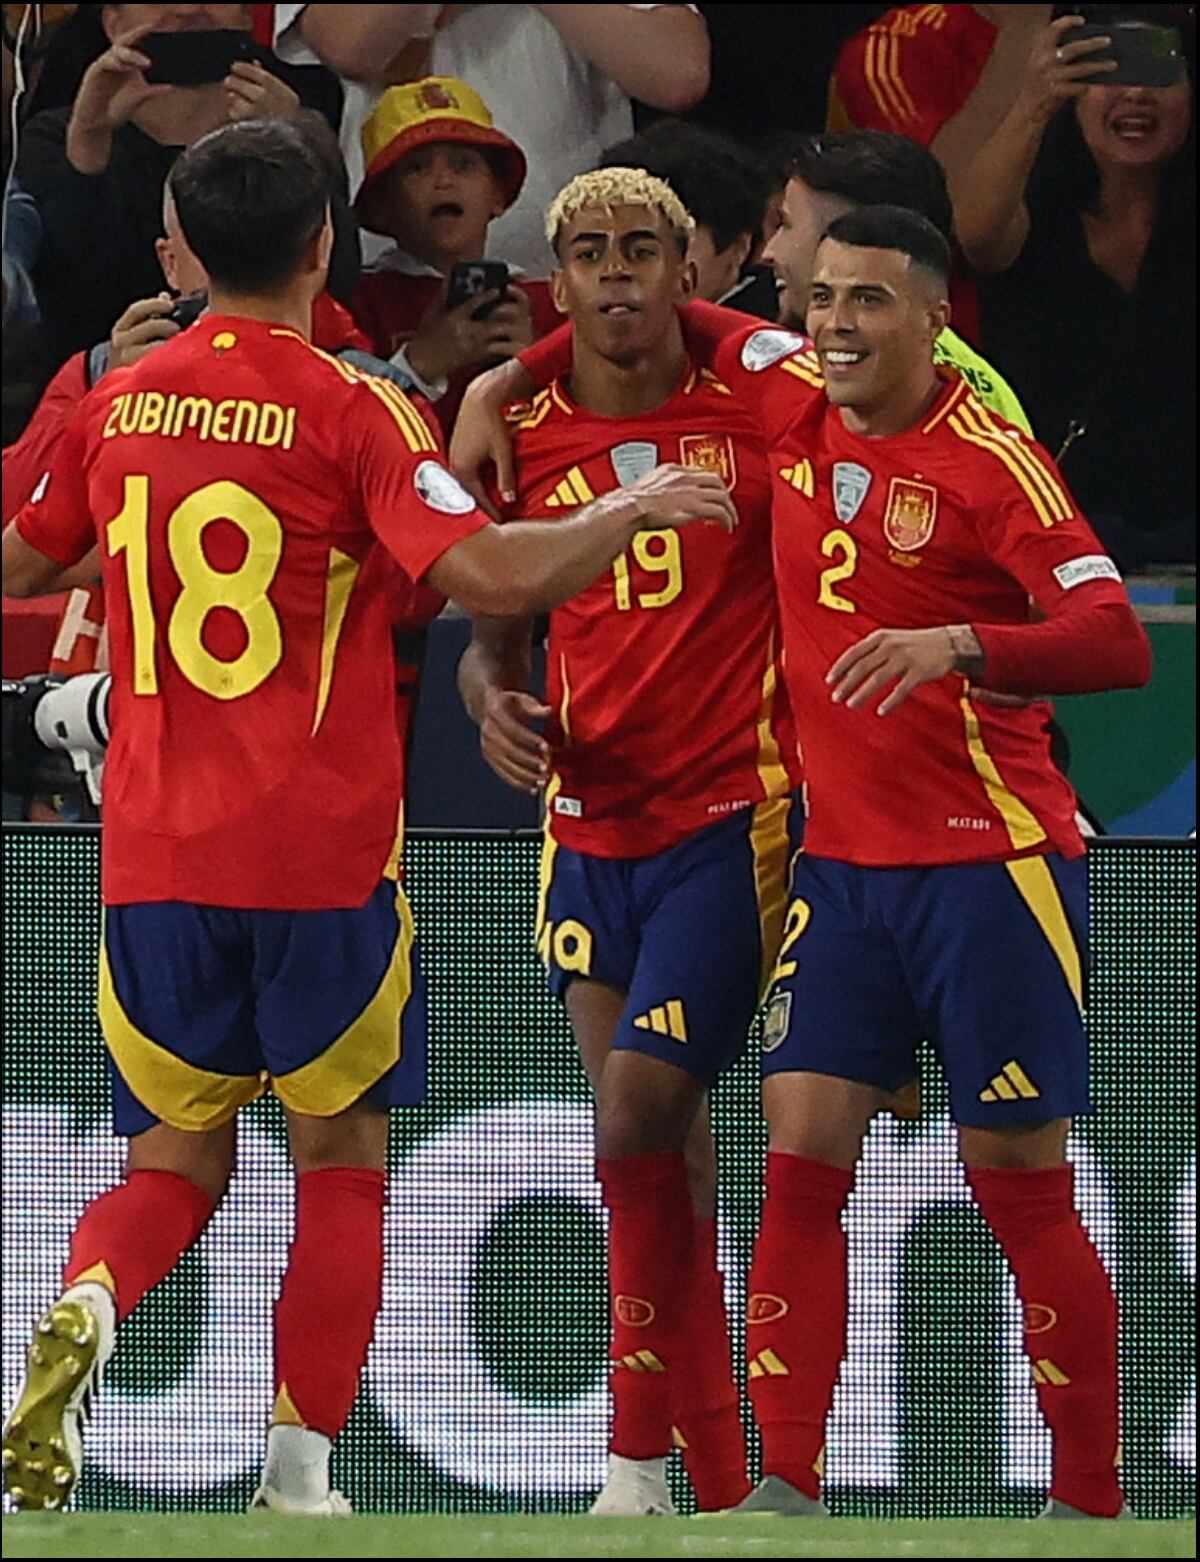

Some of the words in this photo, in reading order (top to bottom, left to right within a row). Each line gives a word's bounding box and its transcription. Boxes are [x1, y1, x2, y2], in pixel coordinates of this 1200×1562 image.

[103, 392, 295, 449] ZUBIMENDI
[107, 475, 282, 700] 18
[613, 528, 682, 611] 19
[818, 529, 857, 613] 2
